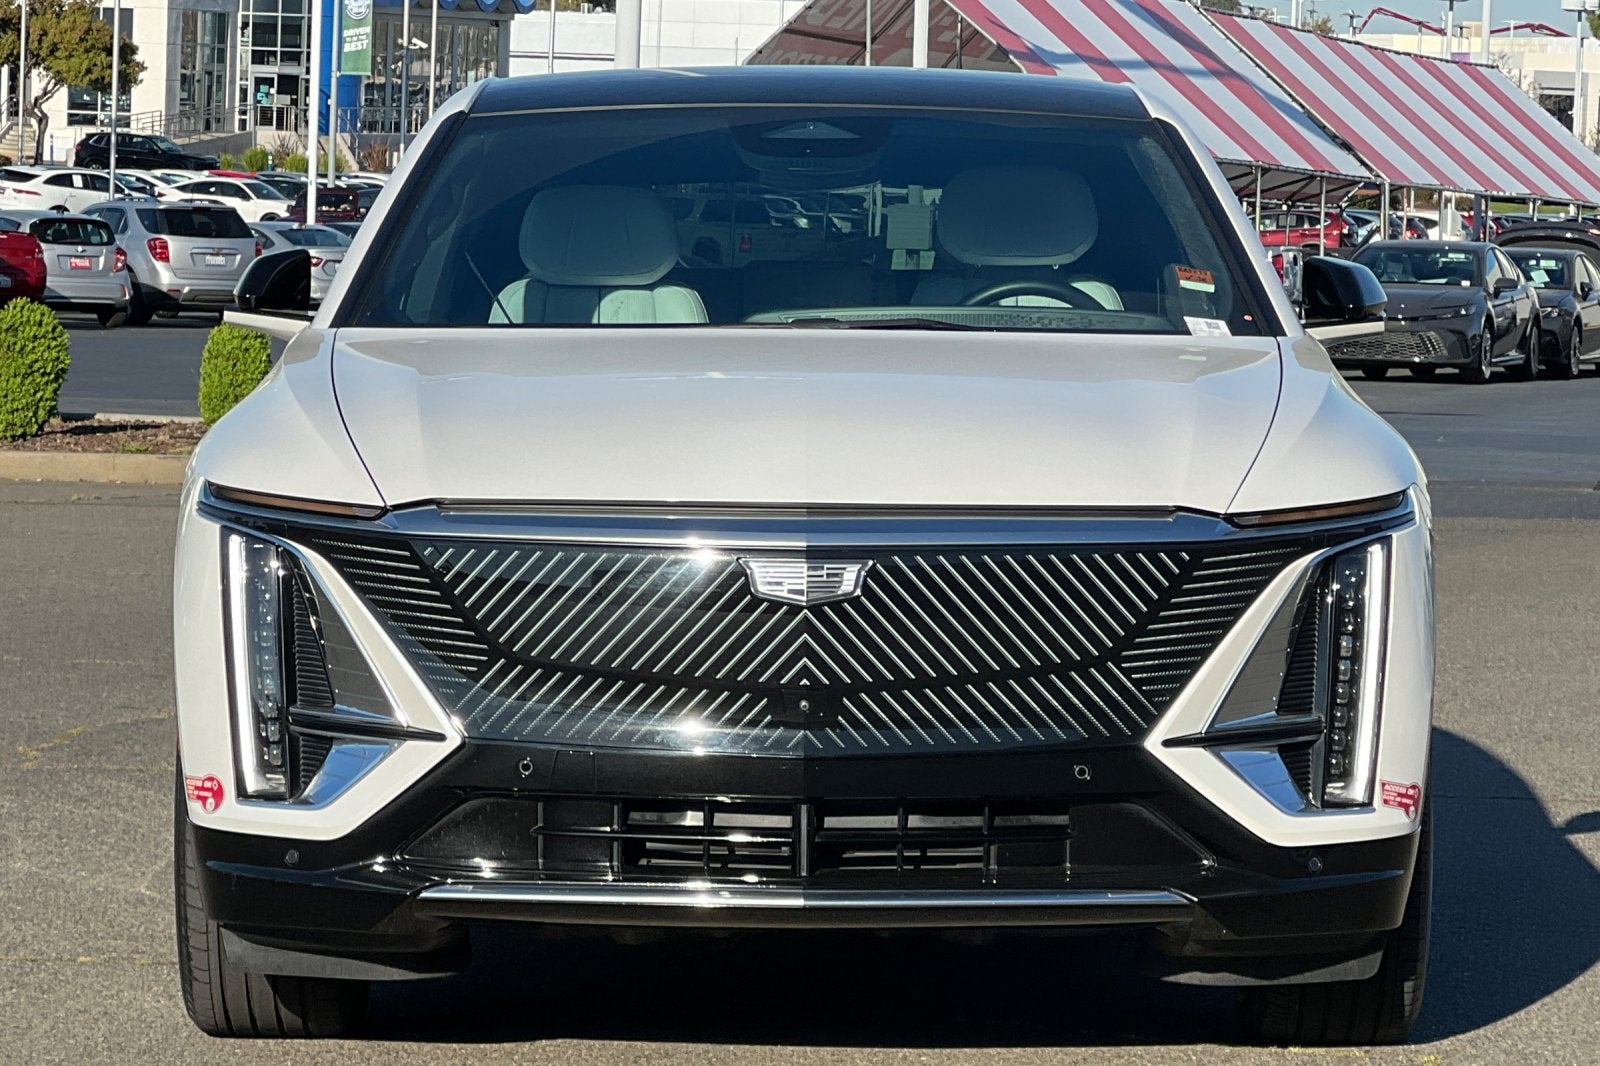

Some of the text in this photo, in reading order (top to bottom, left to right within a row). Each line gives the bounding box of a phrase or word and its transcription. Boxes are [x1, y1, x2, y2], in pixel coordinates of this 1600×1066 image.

[343, 26, 370, 37] DRIVEN
[343, 41, 368, 52] BEST
[203, 780, 212, 788] OK
[1383, 783, 1407, 794] ACCESS
